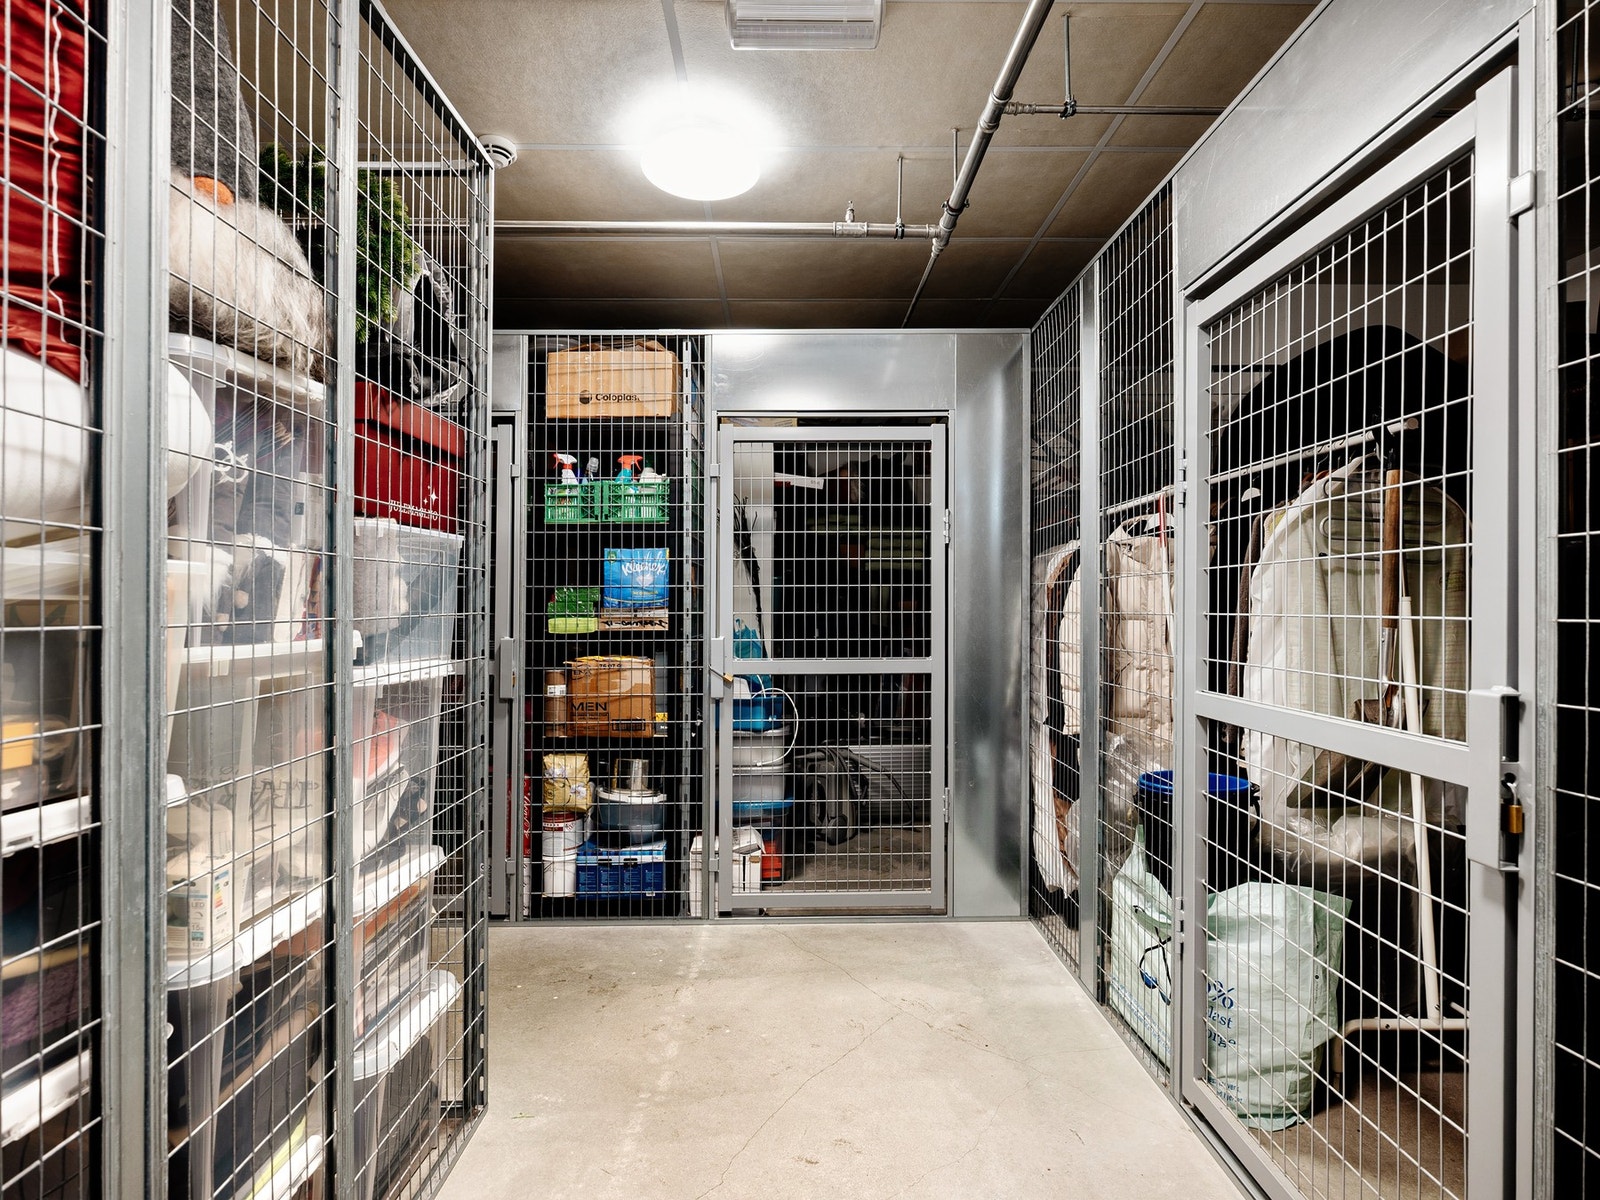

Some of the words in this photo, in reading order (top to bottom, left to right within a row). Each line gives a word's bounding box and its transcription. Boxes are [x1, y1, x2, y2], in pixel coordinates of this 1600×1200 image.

[571, 702, 607, 711] MEN
[1208, 1006, 1232, 1029] last
[1208, 1029, 1236, 1048] orge
